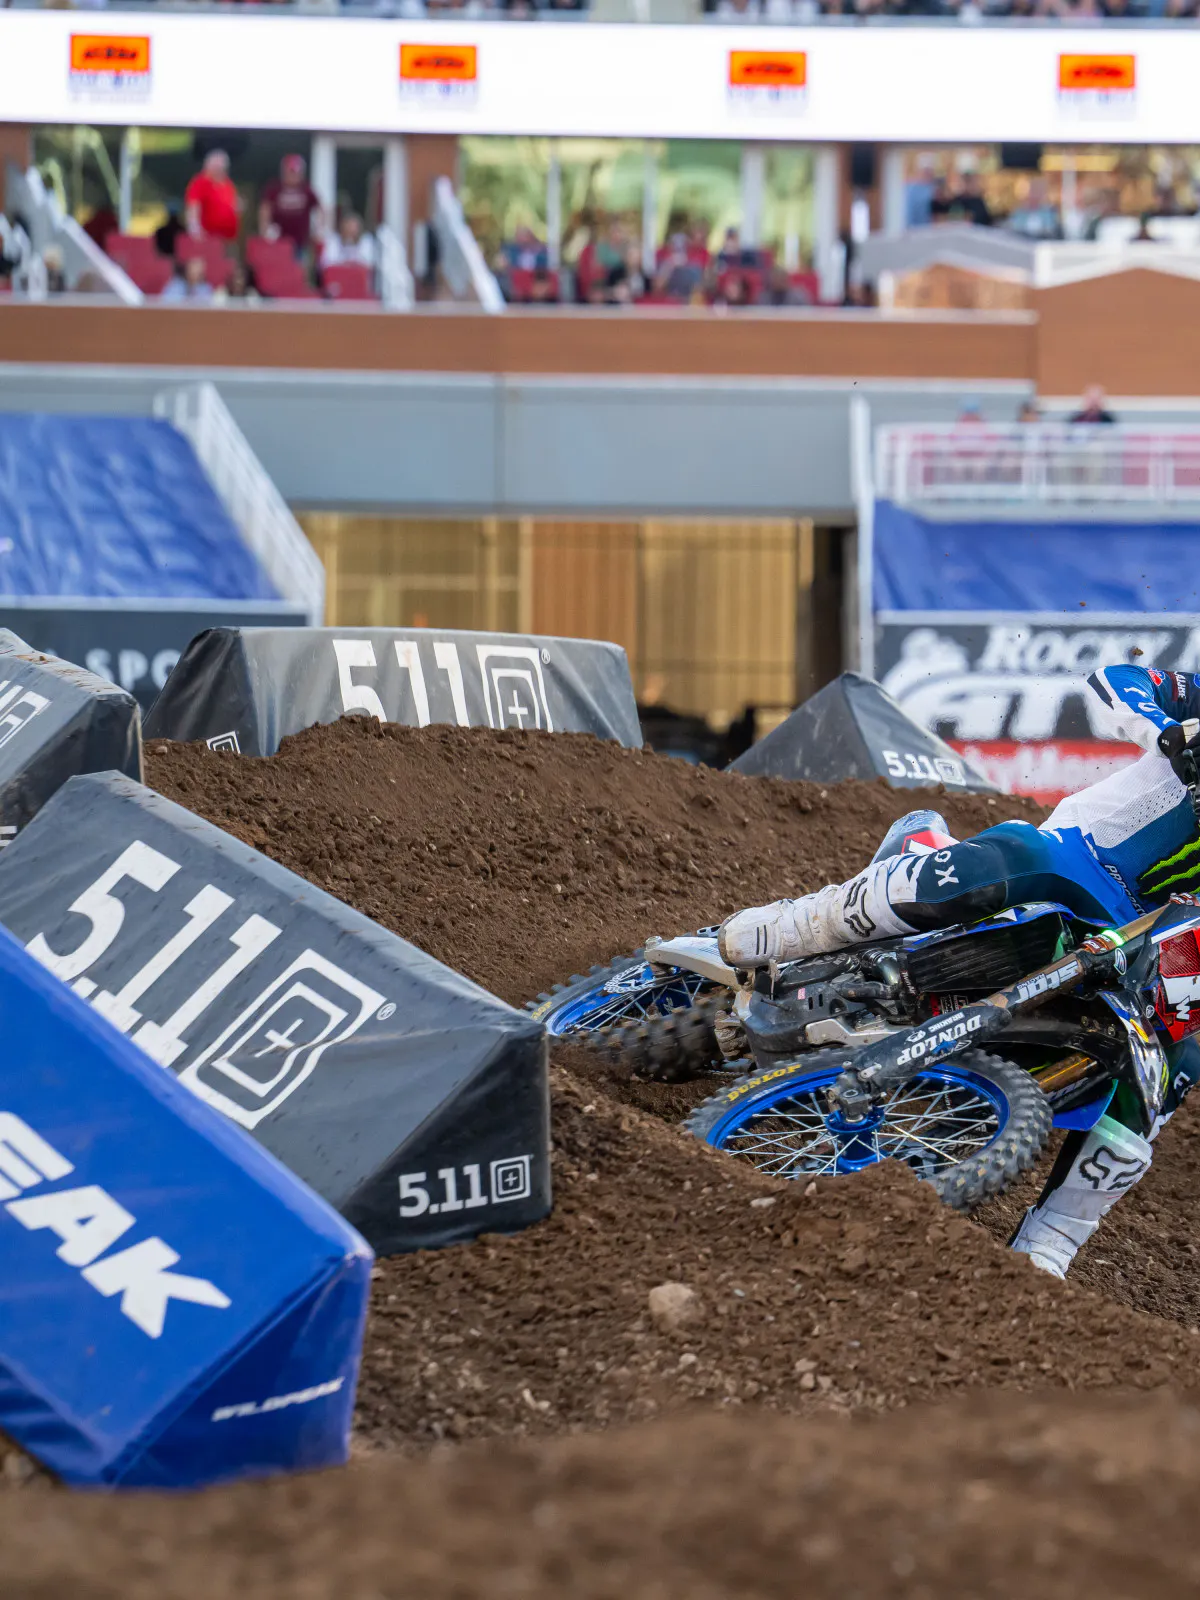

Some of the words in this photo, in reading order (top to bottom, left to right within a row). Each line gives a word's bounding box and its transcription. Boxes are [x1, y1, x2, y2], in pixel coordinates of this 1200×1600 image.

[975, 623, 1173, 672] ROCKY
[882, 750, 943, 782] 5.11
[896, 1014, 983, 1067] DUNLOP
[928, 1012, 965, 1035] BRAKING
[726, 1063, 802, 1102] DUNLOP
[398, 1162, 489, 1218] 5.11
[0, 1110, 233, 1339] EAK
